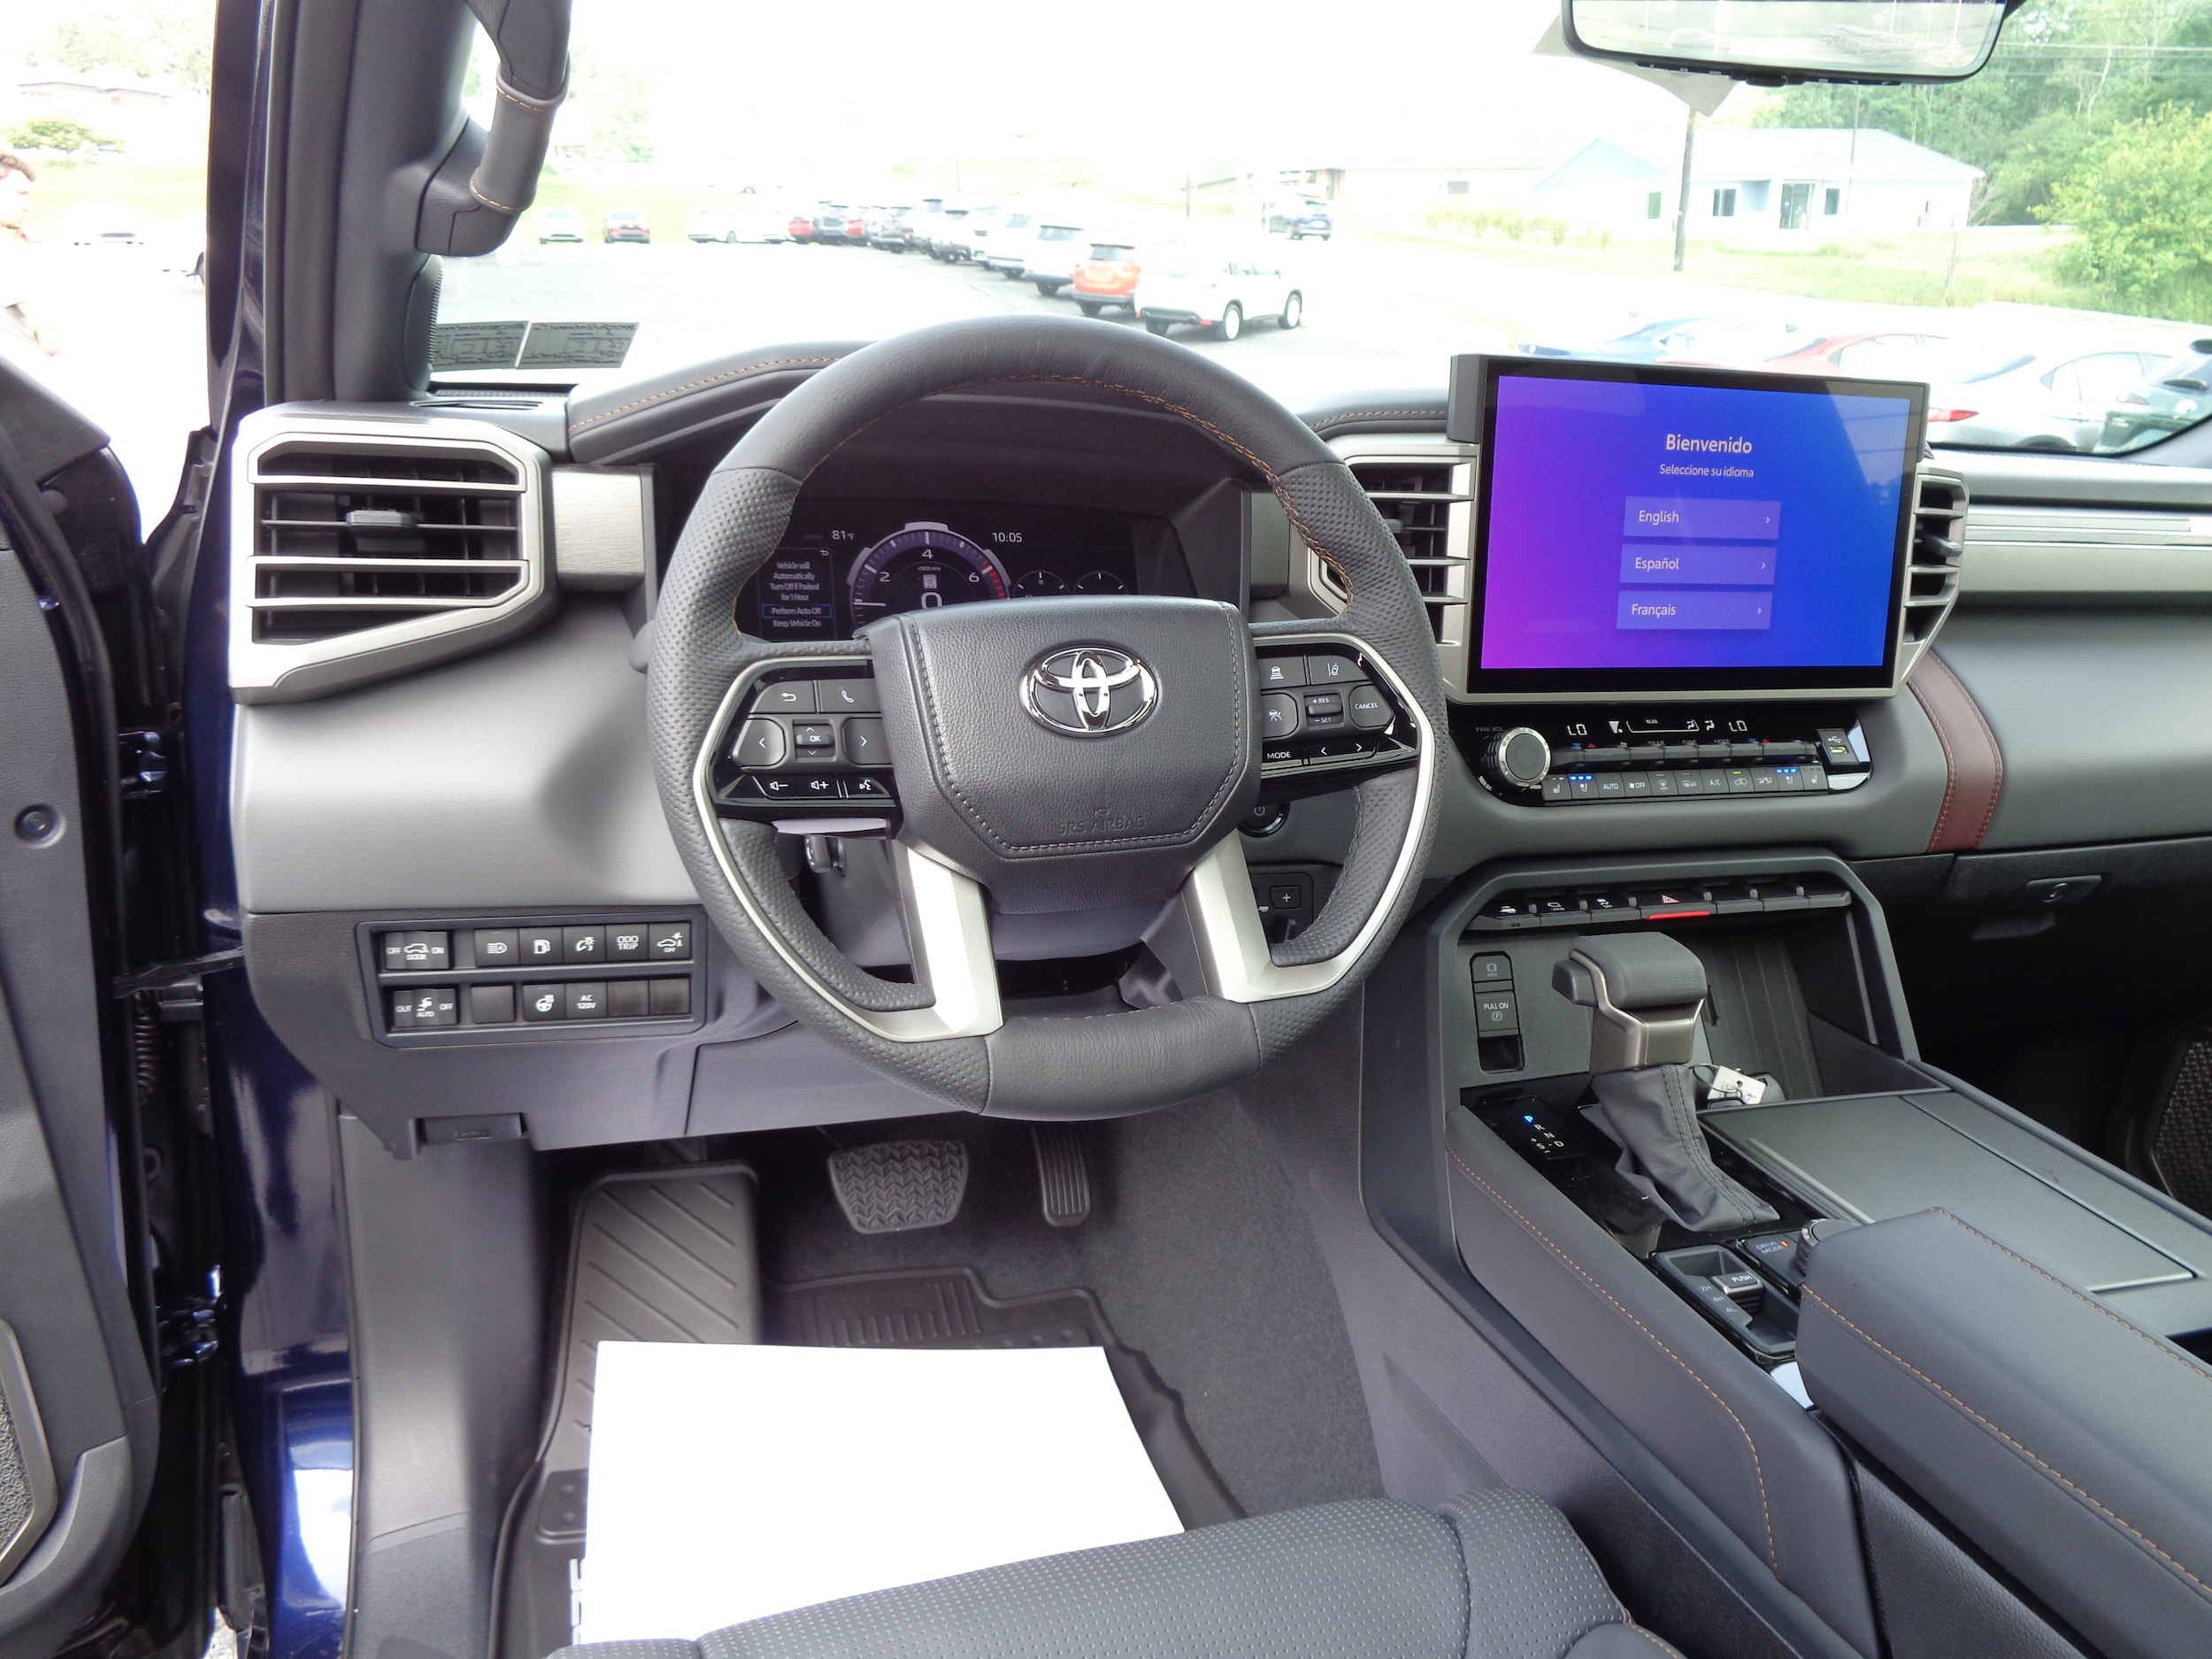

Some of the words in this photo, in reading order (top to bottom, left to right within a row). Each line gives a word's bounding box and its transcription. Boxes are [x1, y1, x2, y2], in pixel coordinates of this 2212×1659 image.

[1665, 433, 1753, 453] Bienvenido
[1659, 464, 1709, 476] Seleccione
[1711, 465, 1722, 477] su
[1723, 465, 1755, 478] idioma
[1638, 510, 1679, 526] English
[992, 532, 1023, 543] 10:05
[921, 549, 933, 559] 4
[776, 561, 798, 570] Vehicle
[1634, 557, 1679, 572] Español
[772, 572, 815, 581] Automatically
[879, 572, 891, 582] 2
[968, 572, 980, 583] 6
[1631, 603, 1677, 618] Français
[1266, 751, 1292, 760] MODE
[1058, 820, 1087, 836] SRS
[1091, 817, 1146, 833] AIRBAG
[1755, 1240, 1778, 1250] DRIVE
[1731, 1274, 1753, 1283] PUSH
